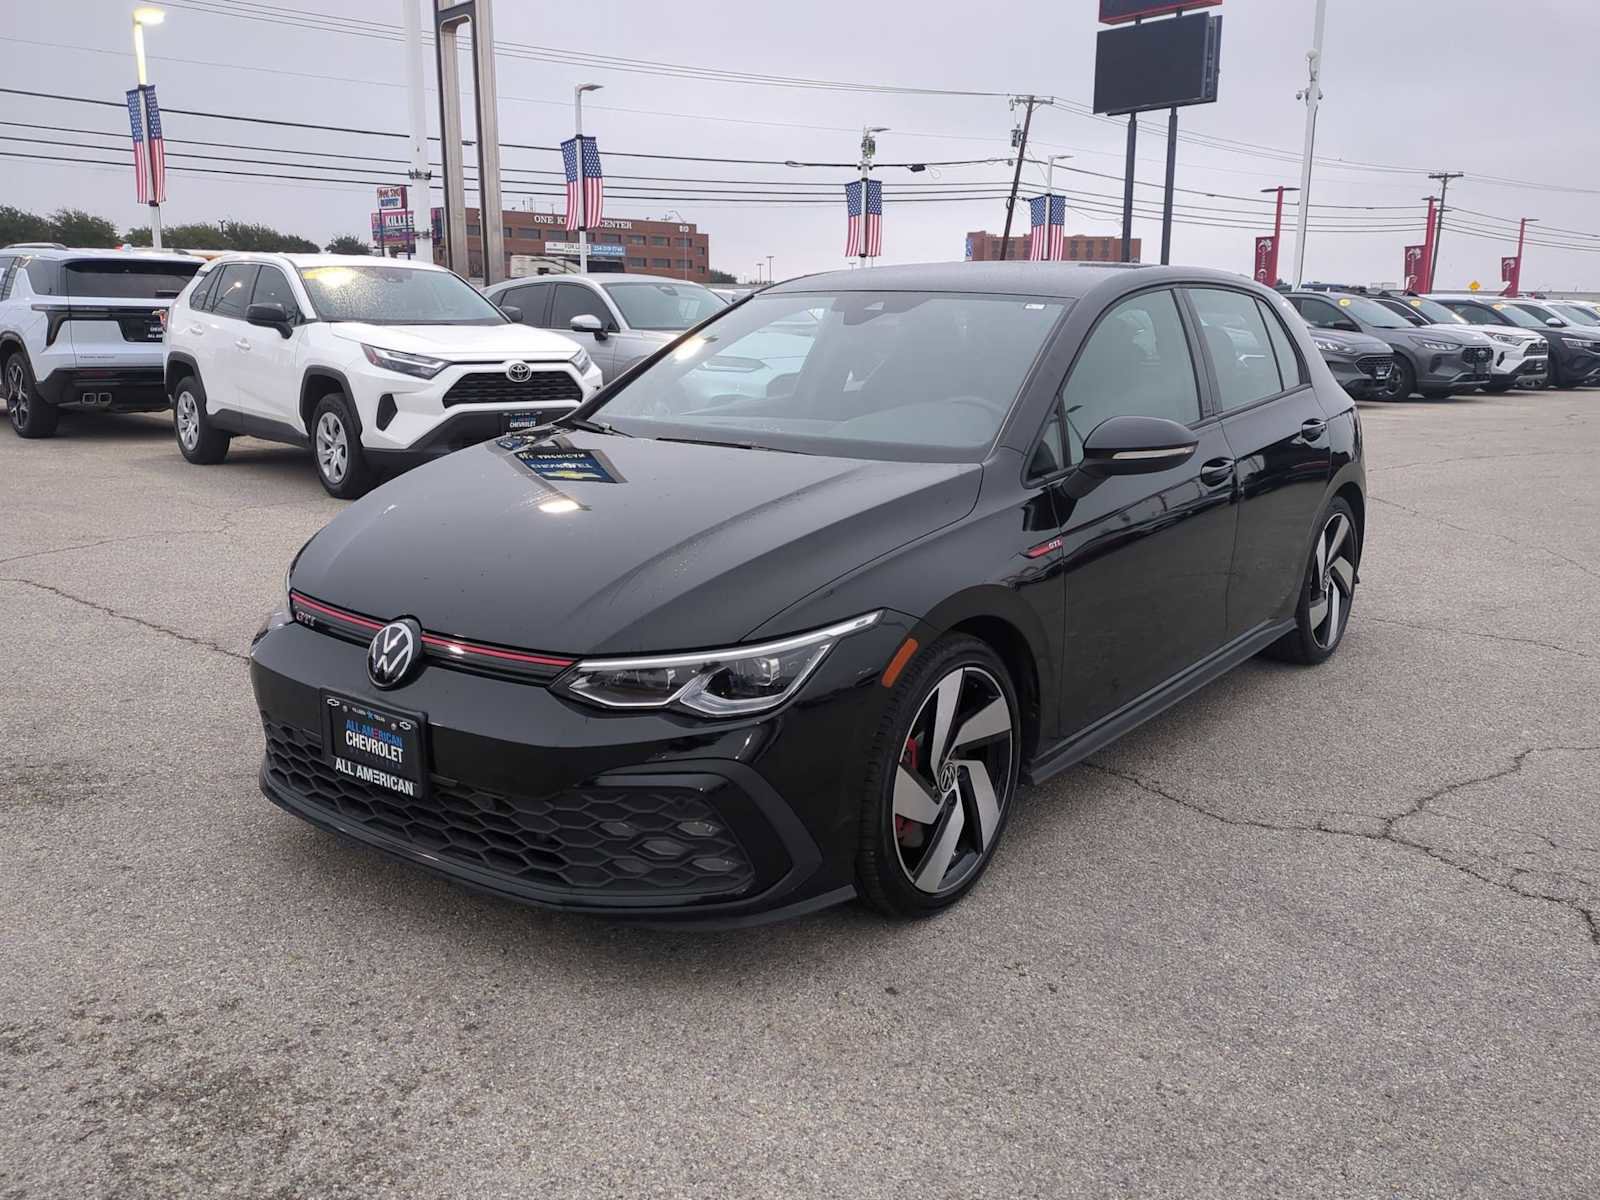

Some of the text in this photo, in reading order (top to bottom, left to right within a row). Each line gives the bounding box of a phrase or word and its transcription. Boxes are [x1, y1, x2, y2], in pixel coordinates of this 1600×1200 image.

[534, 215, 554, 224] ONE
[296, 611, 317, 627] GTI
[345, 730, 404, 763] CHEVROLET
[346, 719, 403, 749] ALL AMERICAN
[335, 757, 414, 796] ALL AMERICAN
